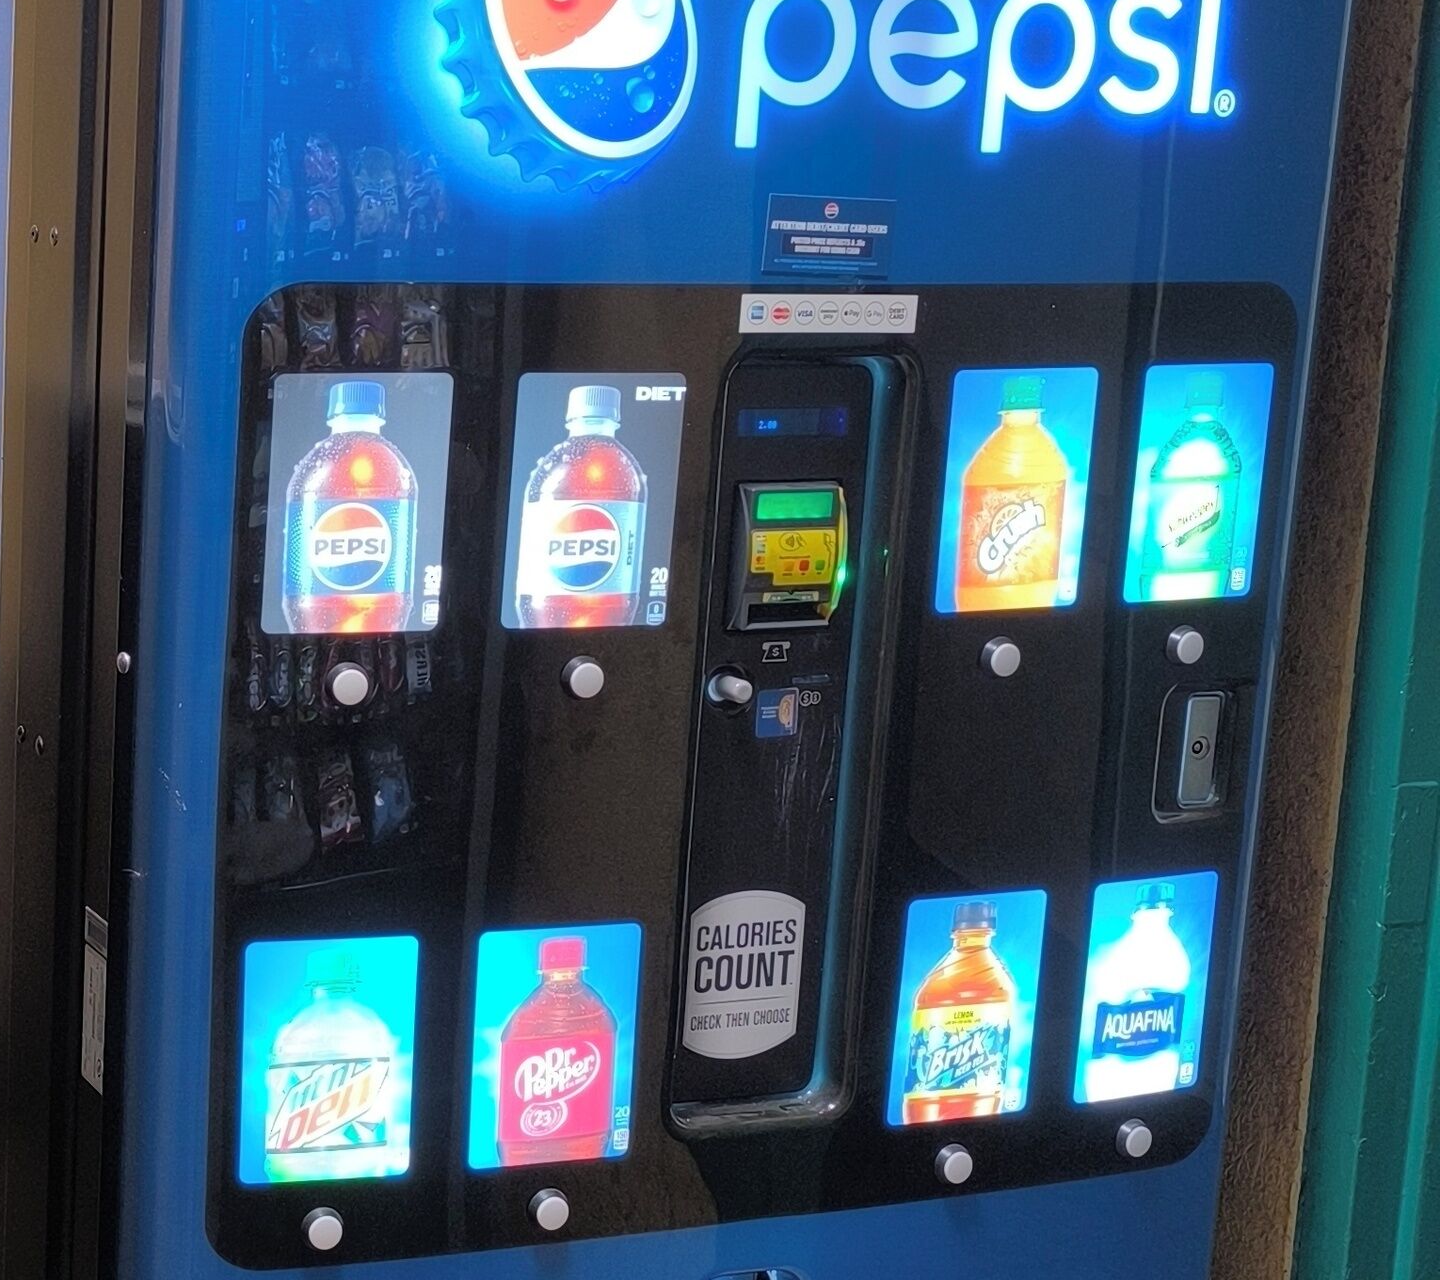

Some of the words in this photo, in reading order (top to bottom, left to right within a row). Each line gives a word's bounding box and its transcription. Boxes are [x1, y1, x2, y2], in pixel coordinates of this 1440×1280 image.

[797, 310, 813, 318] VISA
[635, 386, 687, 401] DIET
[314, 538, 386, 556] PEPSI
[548, 538, 617, 556] PEPSI
[649, 566, 669, 585] 20
[696, 918, 798, 952] CALORIES
[693, 949, 796, 994] COUNT
[690, 1012, 722, 1032] CHECK
[726, 1011, 750, 1027] THEN
[753, 1007, 791, 1026] CHOOSE
[1101, 1005, 1177, 1043] AQUAFINA
[523, 1054, 596, 1102] Pepper
